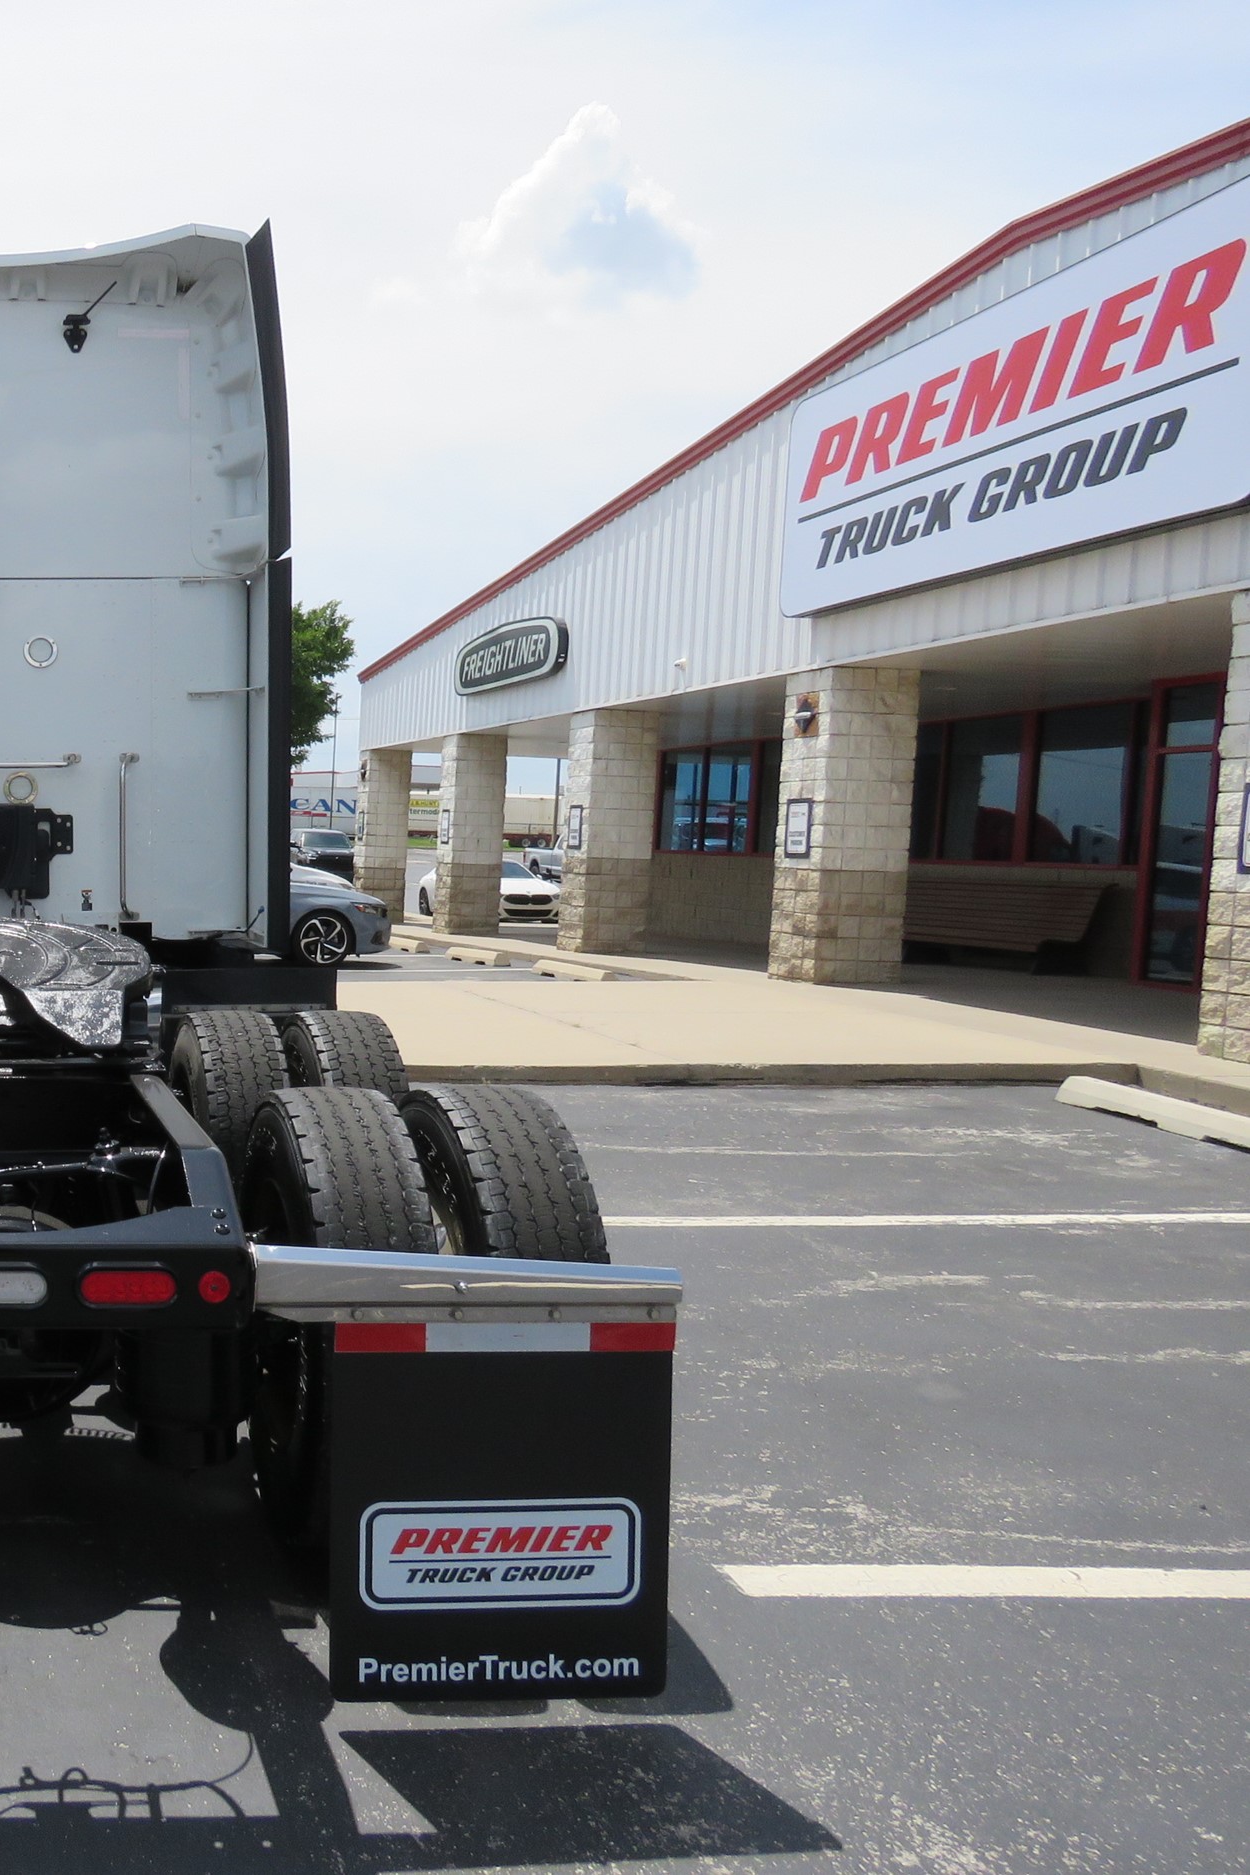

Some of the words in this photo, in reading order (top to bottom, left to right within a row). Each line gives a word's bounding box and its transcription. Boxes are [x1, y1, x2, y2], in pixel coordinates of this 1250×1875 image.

[799, 238, 1247, 503] PREMIER
[816, 482, 966, 569] TRUCK
[967, 407, 1187, 523] GROUP
[462, 633, 546, 682] FREIGHTLINER
[390, 1524, 614, 1554] PREMIER
[405, 1566, 497, 1584] TRUCK
[500, 1564, 595, 1582] GROUP
[358, 1653, 640, 1683] PremierTruck.com
